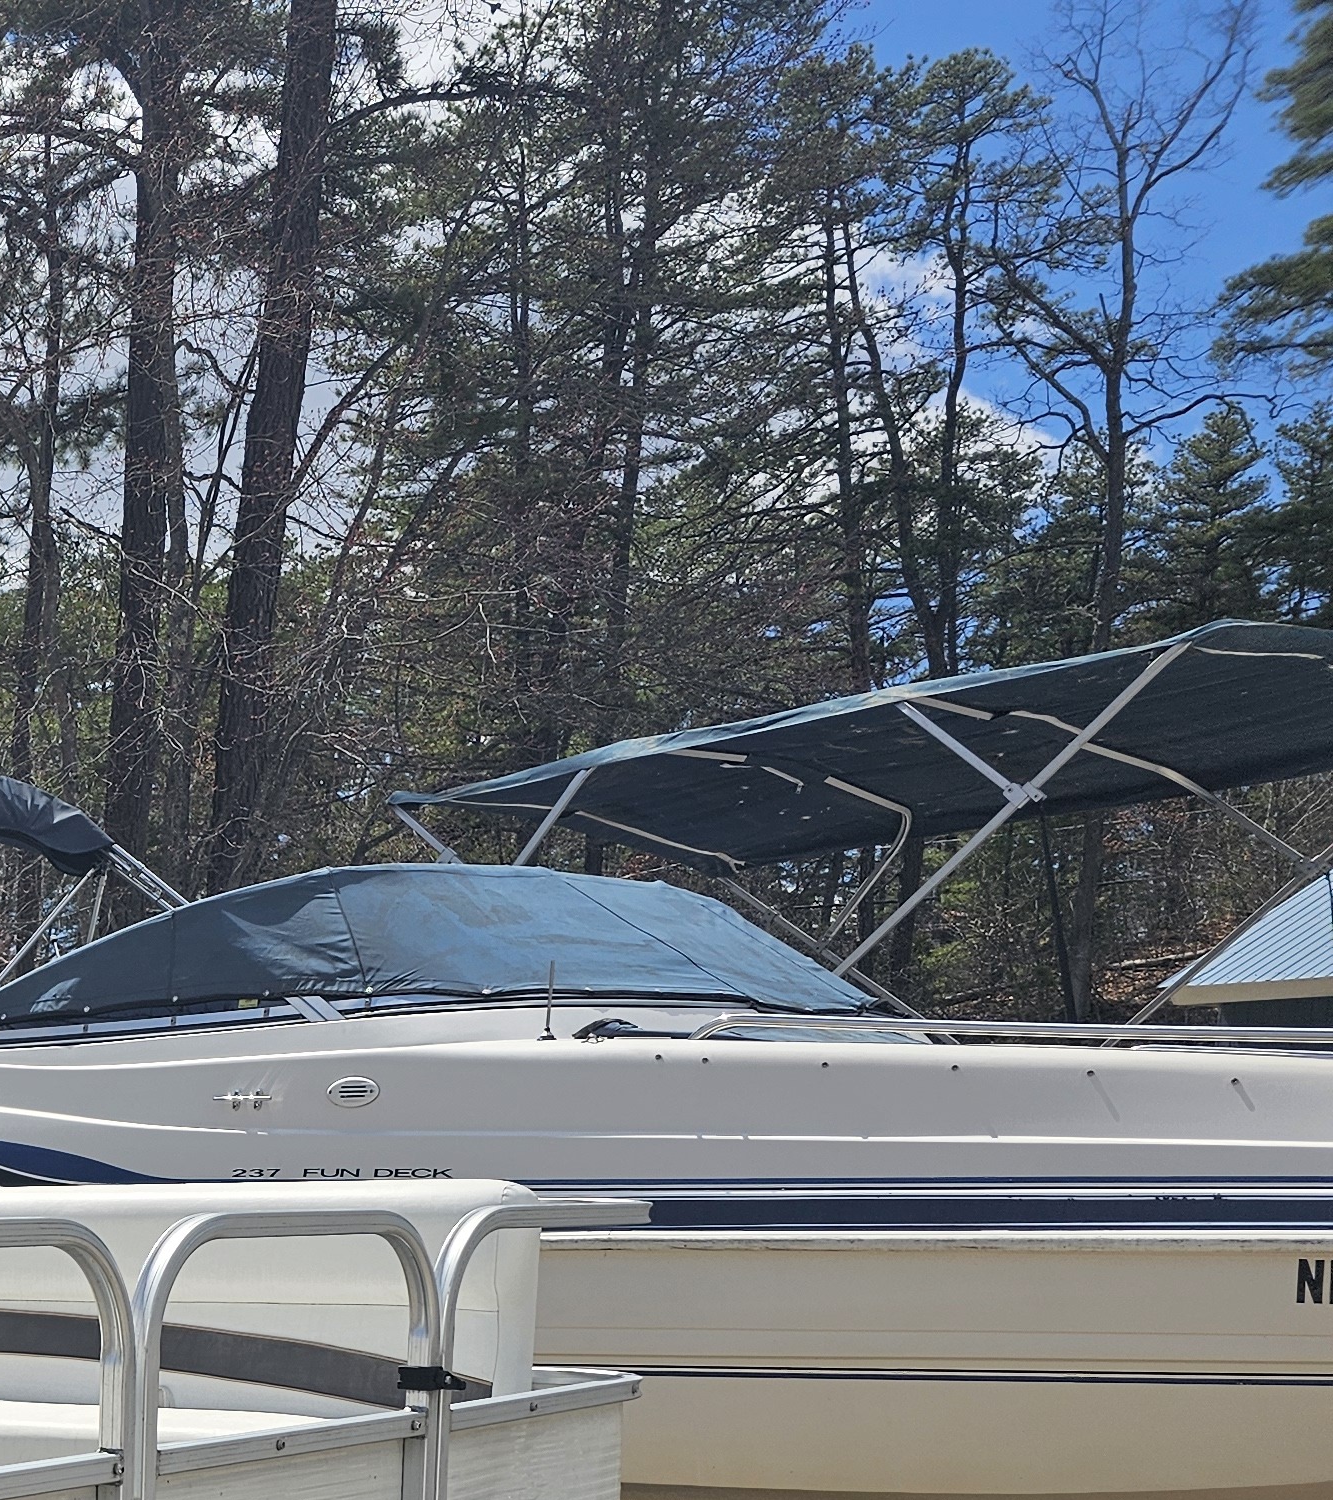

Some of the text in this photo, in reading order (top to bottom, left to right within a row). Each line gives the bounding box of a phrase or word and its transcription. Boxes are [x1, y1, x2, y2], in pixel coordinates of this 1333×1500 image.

[232, 1168, 453, 1178] 237 FUN DECK
[1296, 1258, 1333, 1304] N
